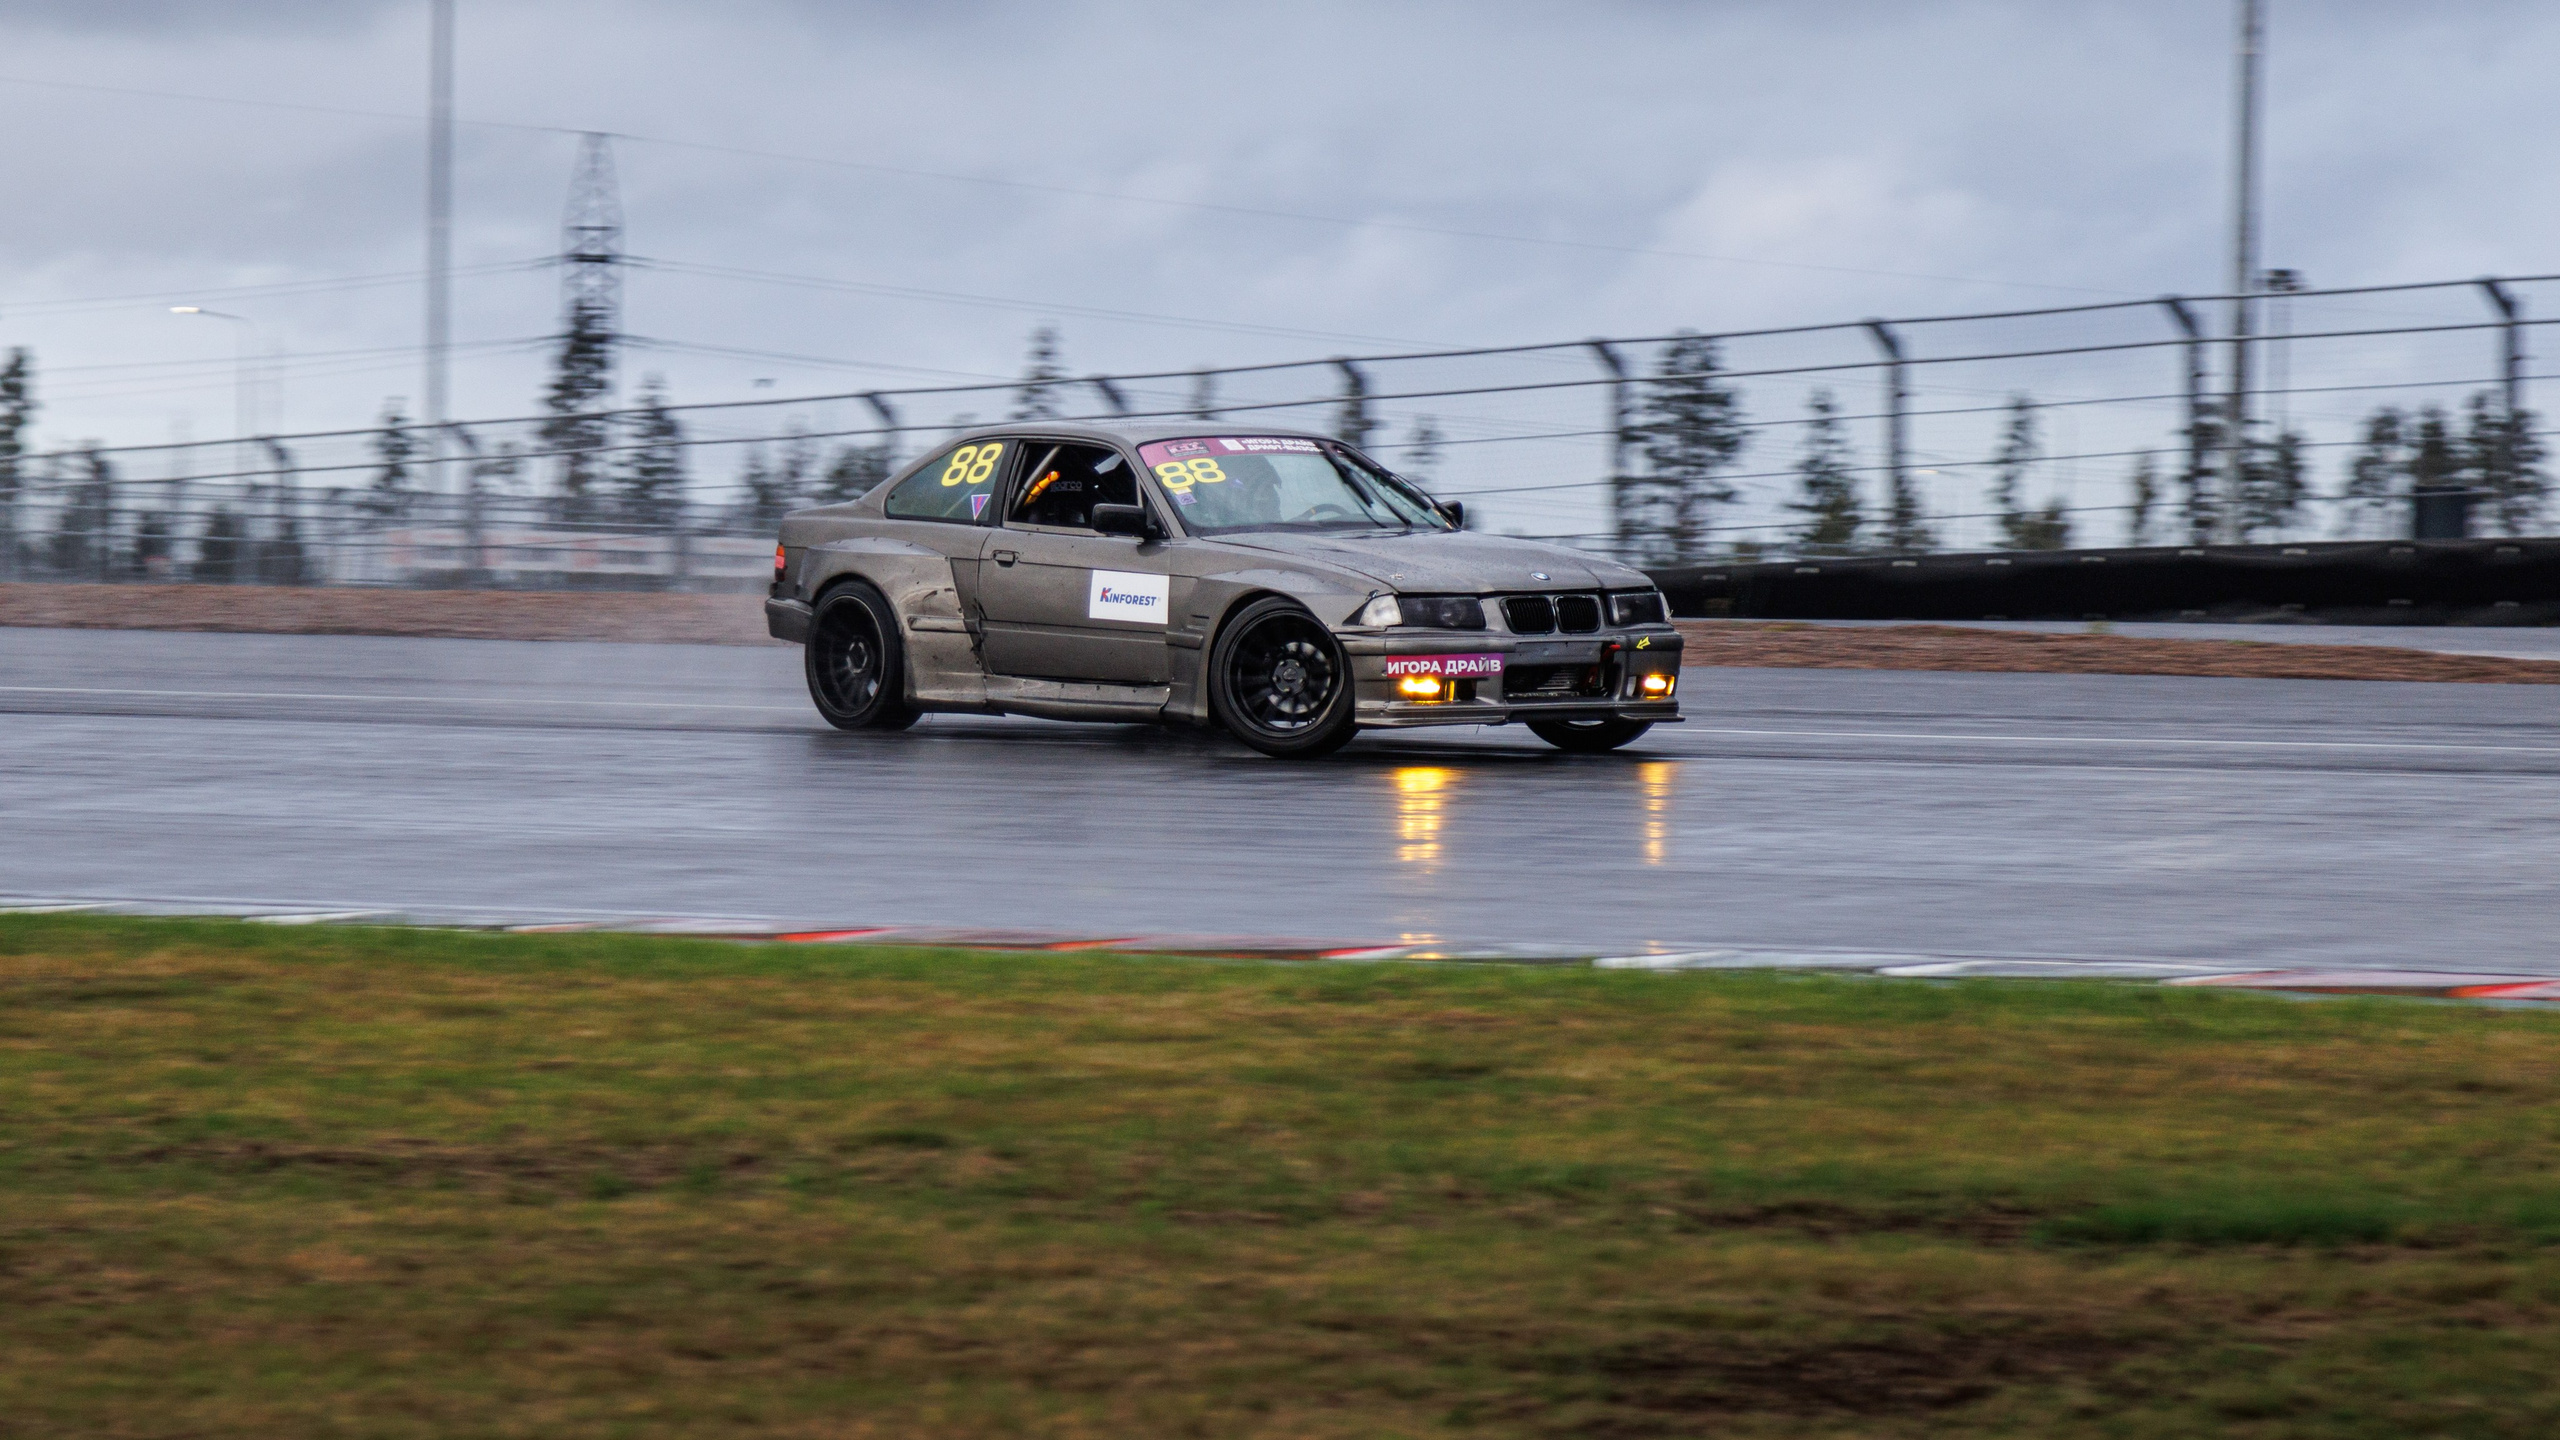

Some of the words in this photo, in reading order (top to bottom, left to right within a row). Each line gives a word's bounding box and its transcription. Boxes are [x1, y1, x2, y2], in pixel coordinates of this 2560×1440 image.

[941, 443, 1003, 487] 88
[1155, 458, 1226, 489] 88
[1387, 660, 1441, 675] ИГОРА
[1445, 657, 1502, 675] ДРАЙВ
